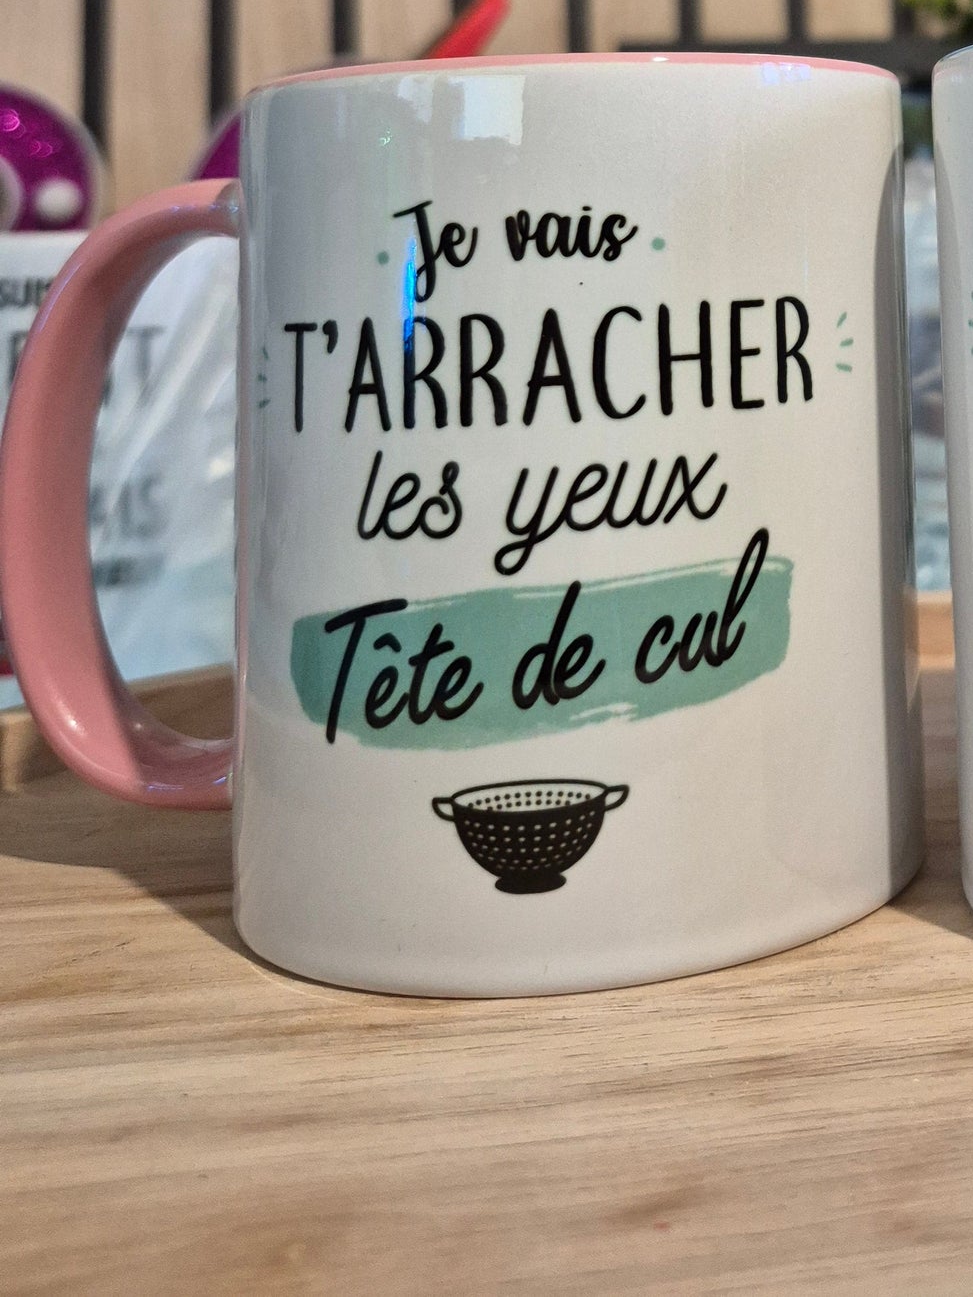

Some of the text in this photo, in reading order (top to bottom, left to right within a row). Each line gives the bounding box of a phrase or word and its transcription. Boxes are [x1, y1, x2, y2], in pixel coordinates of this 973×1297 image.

[393, 200, 639, 303] Je vais
[284, 296, 813, 433] T’ARRACHER
[357, 450, 728, 576] les yeux
[324, 528, 770, 745] Tête de cul
